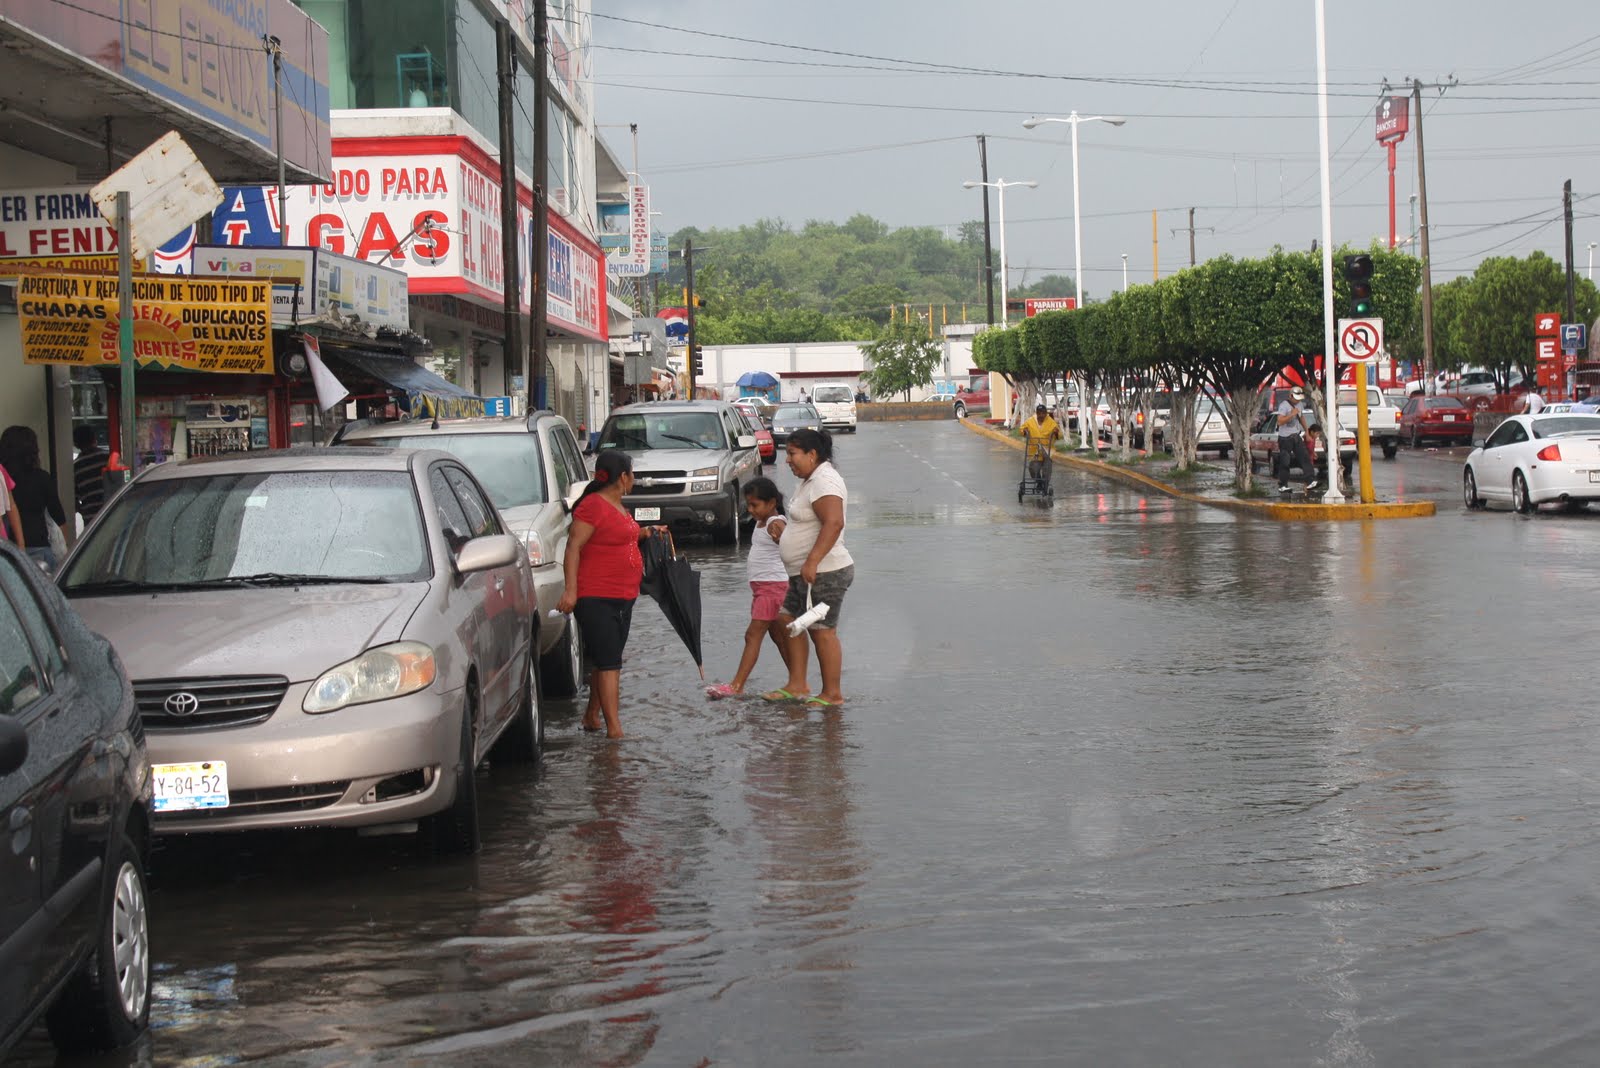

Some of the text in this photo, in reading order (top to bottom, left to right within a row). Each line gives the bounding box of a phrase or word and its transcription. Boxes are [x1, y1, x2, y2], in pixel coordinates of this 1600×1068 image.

[179, 6, 267, 126] FENIX
[382, 167, 448, 195] PARA
[460, 162, 486, 212] TODO
[0, 196, 27, 222] ER
[633, 187, 648, 264] ESTACIONAMIENTO
[308, 210, 450, 261] GAS
[462, 208, 476, 272] EL
[70, 258, 142, 271] MINUTS
[207, 257, 252, 272] viva
[608, 263, 645, 274] ENTRADA
[21, 277, 266, 303] APERTURA Y REPAACION DE TODO TIPO DE
[272, 296, 290, 305] VENTA
[1033, 301, 1067, 309] PAPANTLA
[22, 301, 107, 319] CHAPAS
[182, 309, 266, 326] DUPLICADOS
[25, 320, 91, 333] AUTOMOTRIZ
[193, 325, 267, 341] DE LLAVES
[25, 334, 90, 347] RESIDENCIAL
[27, 348, 85, 362] COMERCIAL
[1539, 341, 1555, 358] E
[198, 358, 219, 369] TIPO
